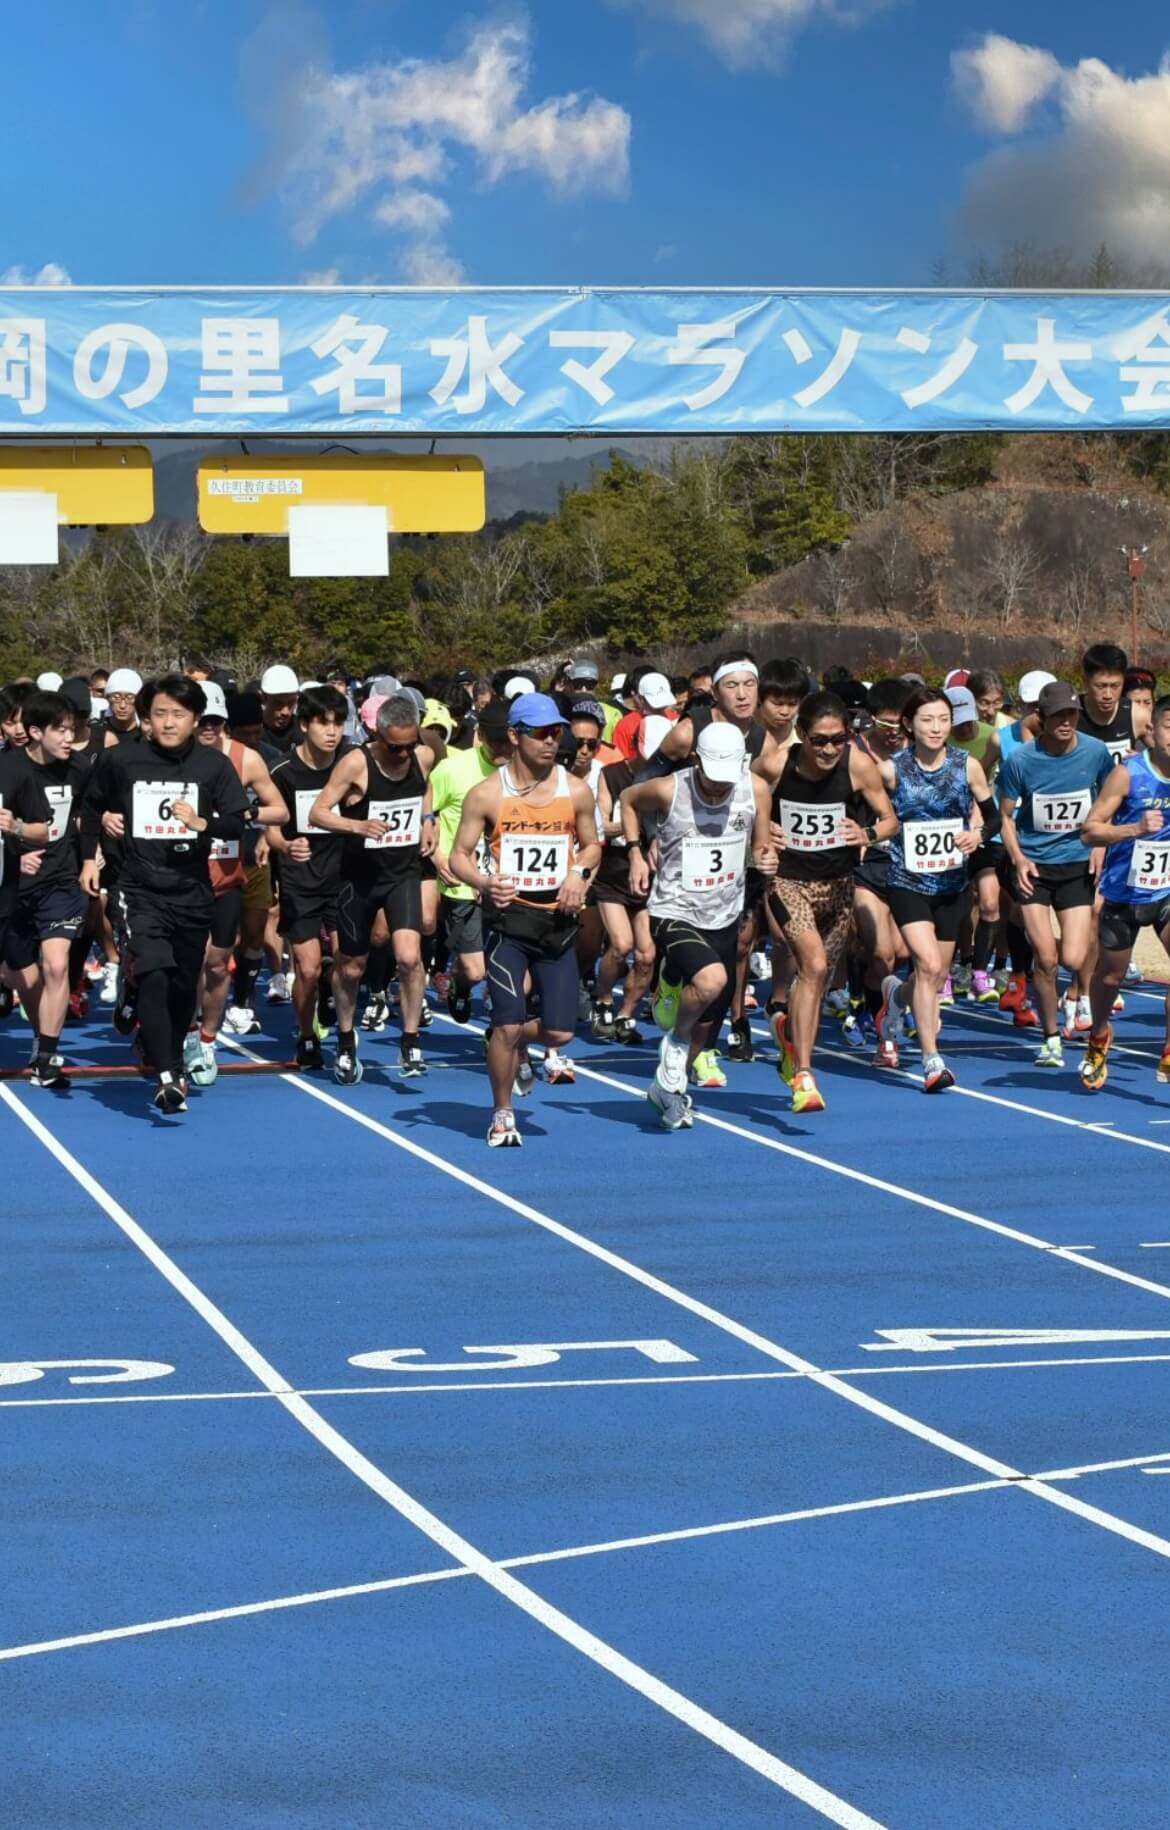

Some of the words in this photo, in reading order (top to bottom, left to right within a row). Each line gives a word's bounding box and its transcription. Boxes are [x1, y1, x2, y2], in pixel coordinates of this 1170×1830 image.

[158, 798, 172, 821] 6
[1043, 801, 1082, 820] 127
[790, 812, 835, 836] 253
[914, 831, 955, 856] 820
[513, 848, 558, 872] 124
[709, 849, 723, 873] 3
[1141, 852, 1168, 873] 31
[349, 1340, 699, 1371] 5
